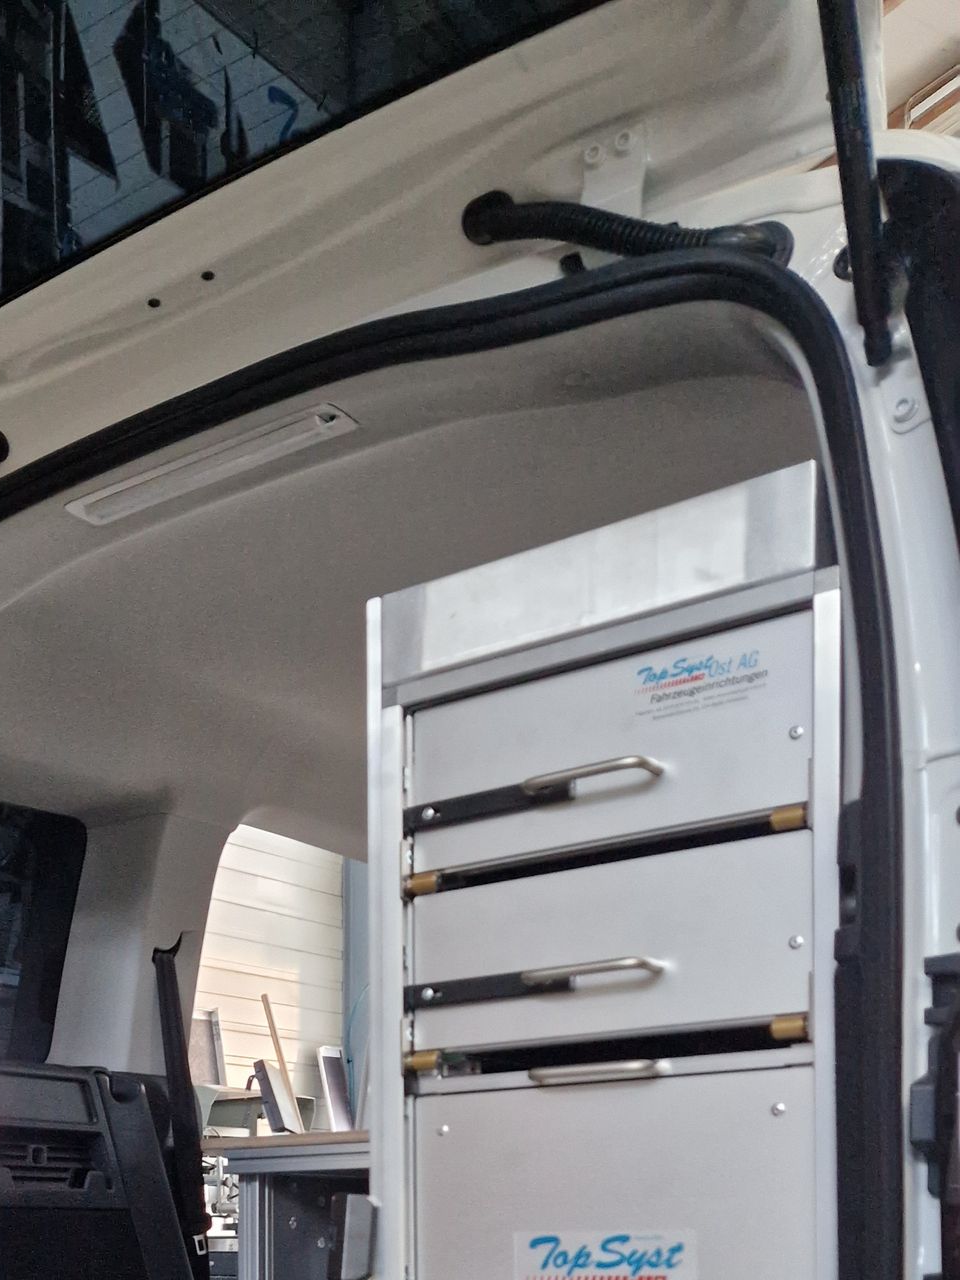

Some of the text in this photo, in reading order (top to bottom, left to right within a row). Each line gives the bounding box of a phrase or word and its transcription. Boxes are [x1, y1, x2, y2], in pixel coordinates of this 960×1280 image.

[737, 650, 759, 670] AG
[650, 669, 768, 703] Fahrzeugeinrichtungen
[528, 1234, 684, 1277] TopSyst
